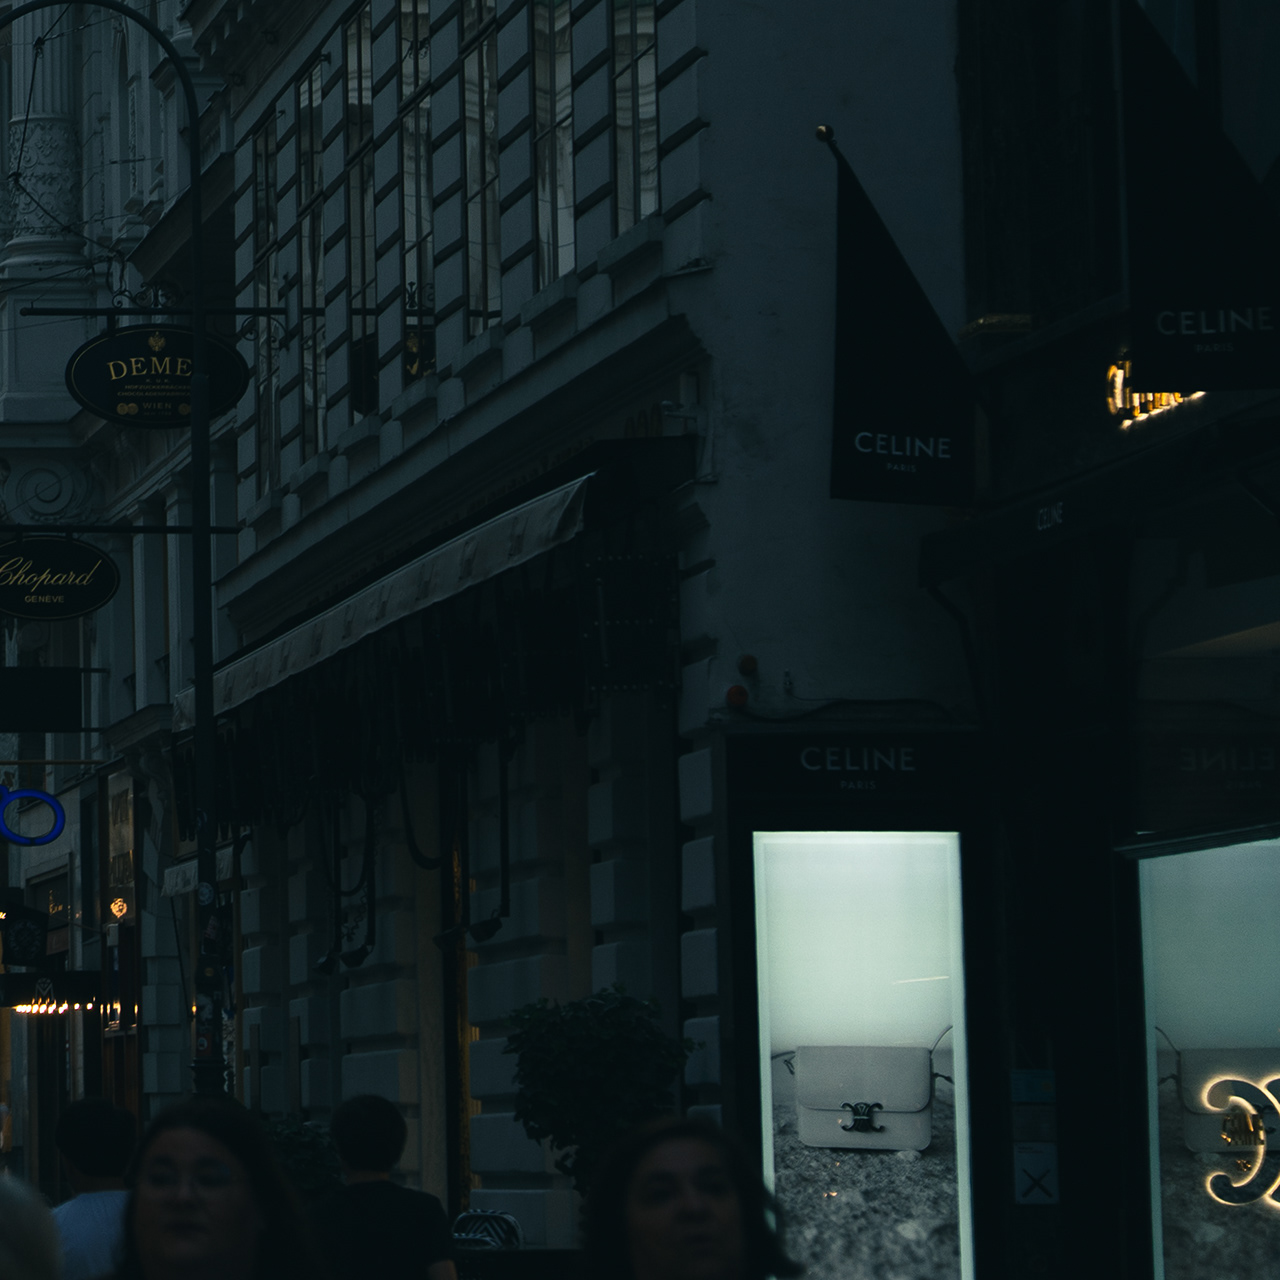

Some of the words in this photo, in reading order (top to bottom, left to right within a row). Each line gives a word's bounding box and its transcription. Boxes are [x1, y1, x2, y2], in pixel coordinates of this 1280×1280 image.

[1156, 306, 1274, 336] CELINE
[1194, 342, 1235, 353] PARIS
[106, 356, 192, 381] DEME
[854, 431, 952, 459] CELINE
[886, 462, 917, 473] PARIS
[800, 746, 916, 771] CELINE
[840, 780, 877, 790] PARIS
